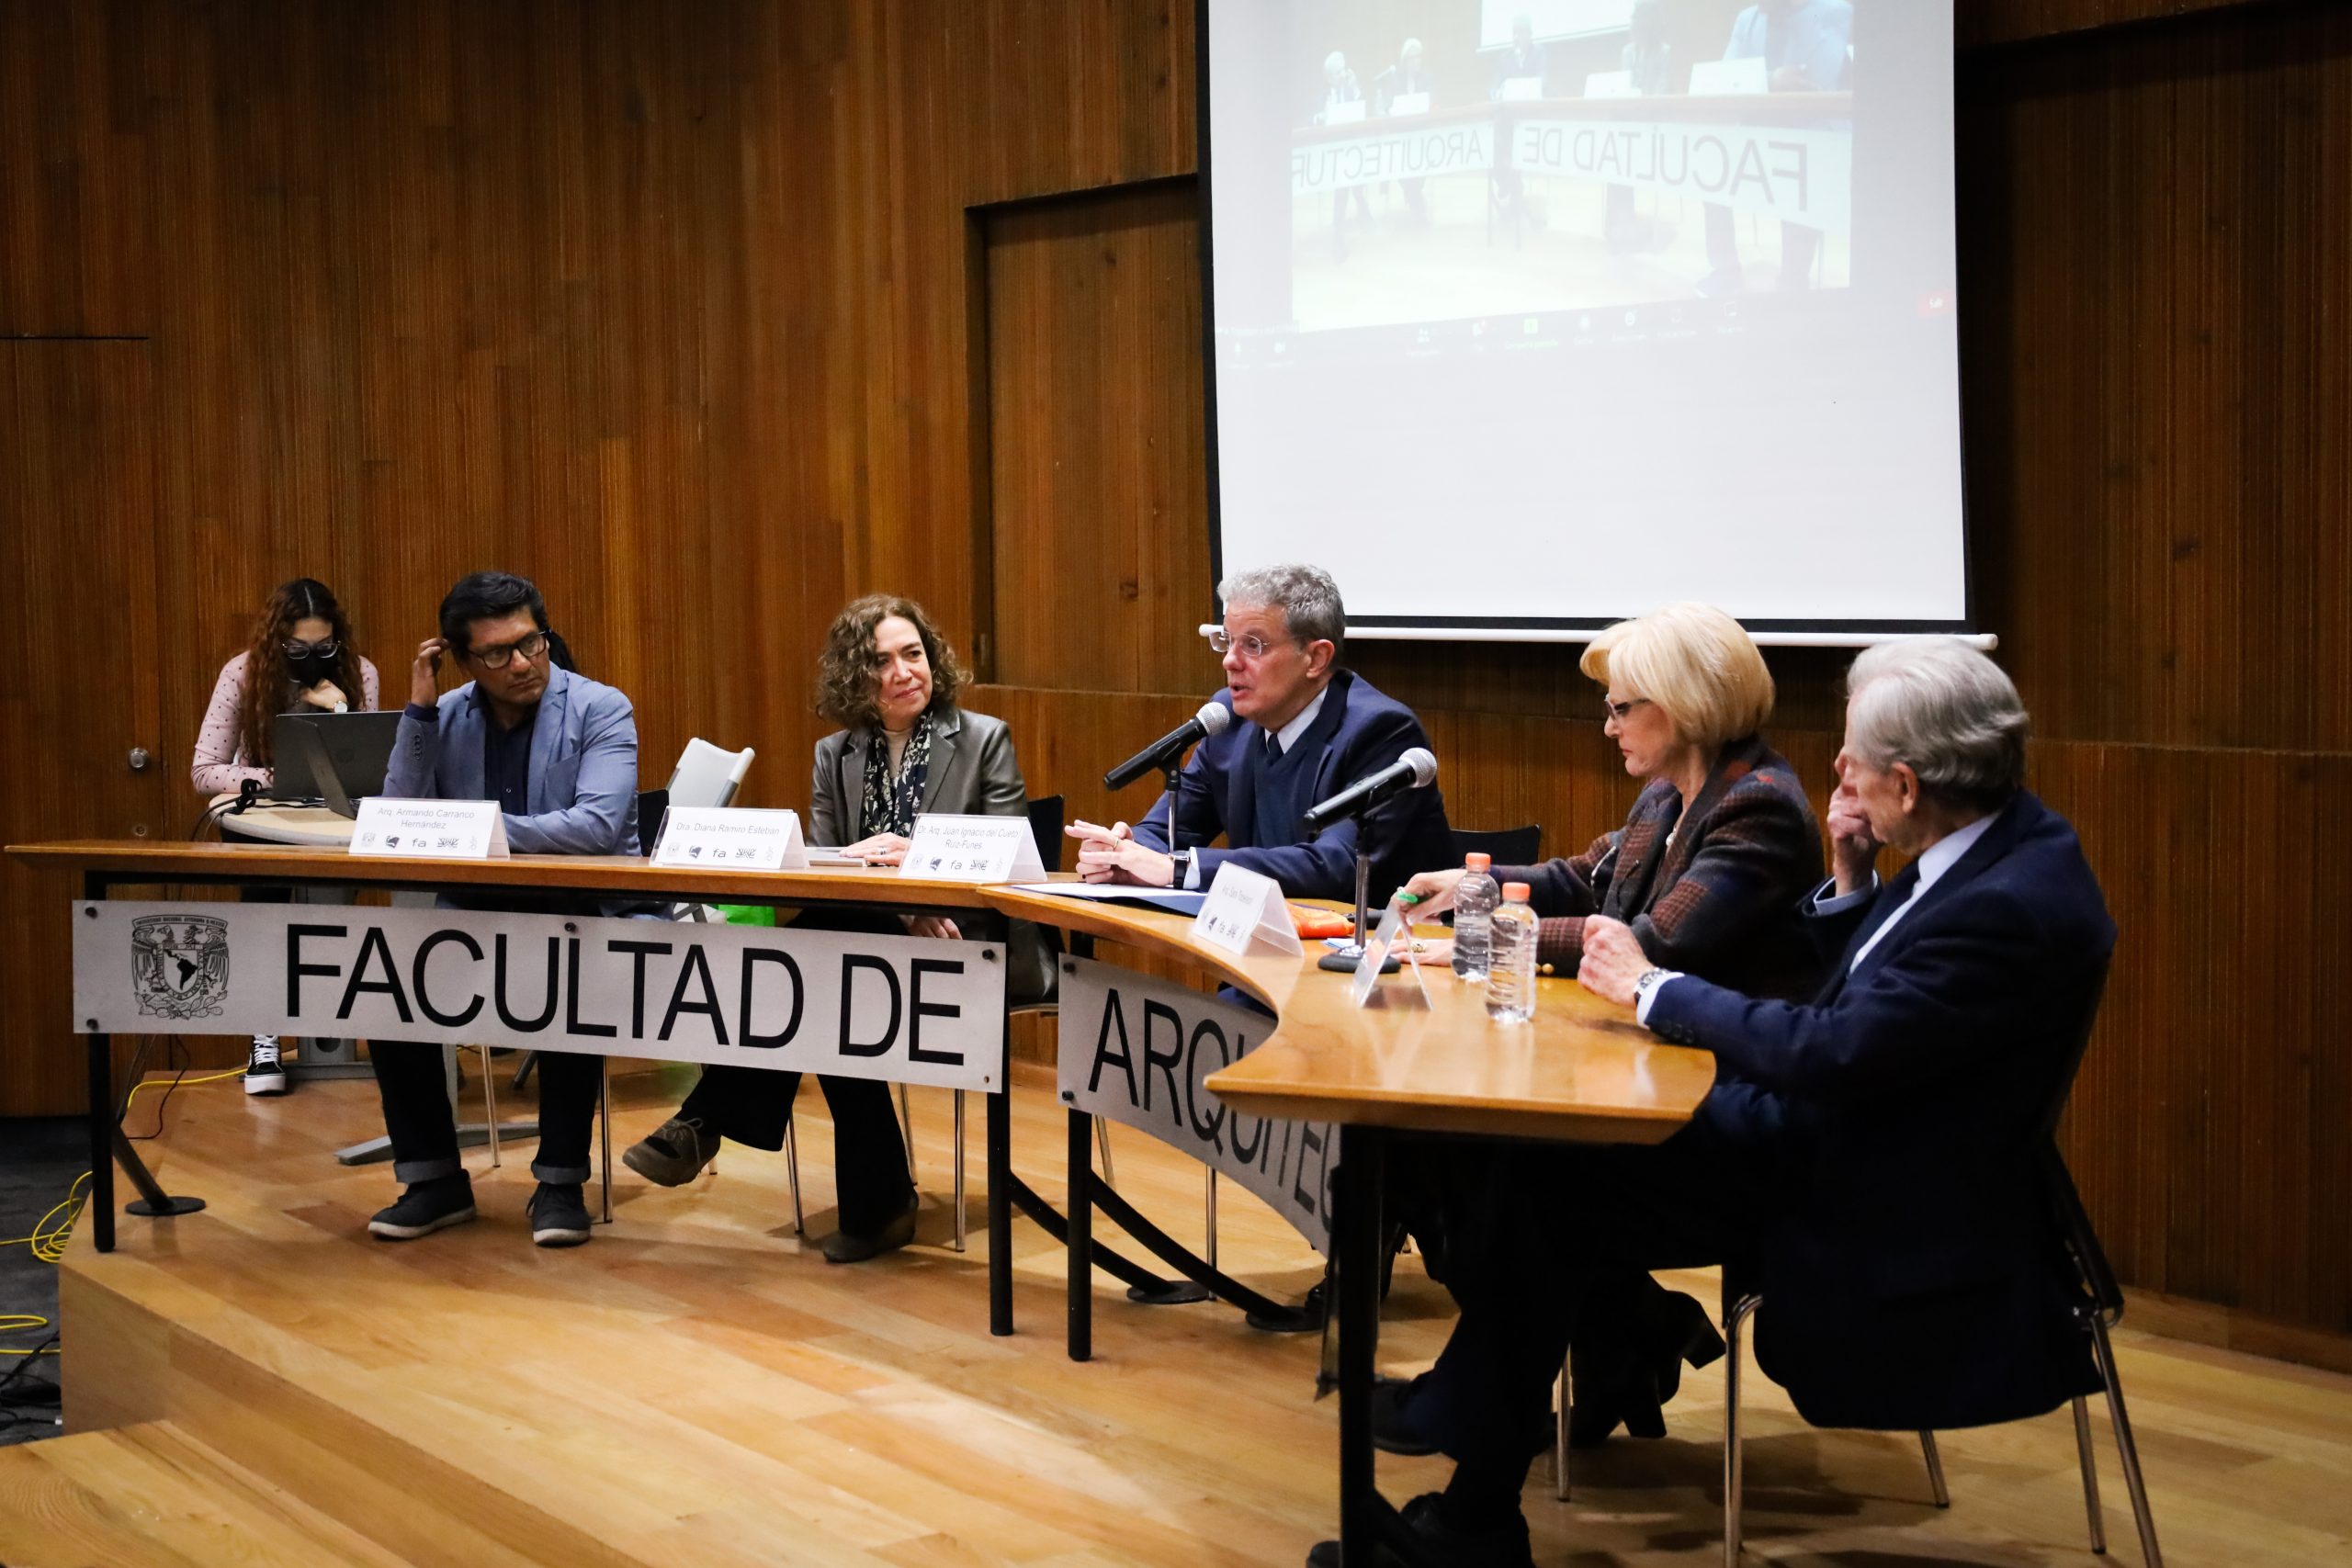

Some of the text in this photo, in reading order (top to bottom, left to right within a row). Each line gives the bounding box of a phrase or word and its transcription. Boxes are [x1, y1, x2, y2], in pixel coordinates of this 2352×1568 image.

[396, 807, 434, 817] Armando
[435, 809, 475, 818] Carranco
[748, 825, 780, 835] Esteban
[412, 838, 426, 848] fa
[712, 848, 727, 858] fa
[286, 923, 804, 1049] FACULTAD
[838, 953, 966, 1066] DE
